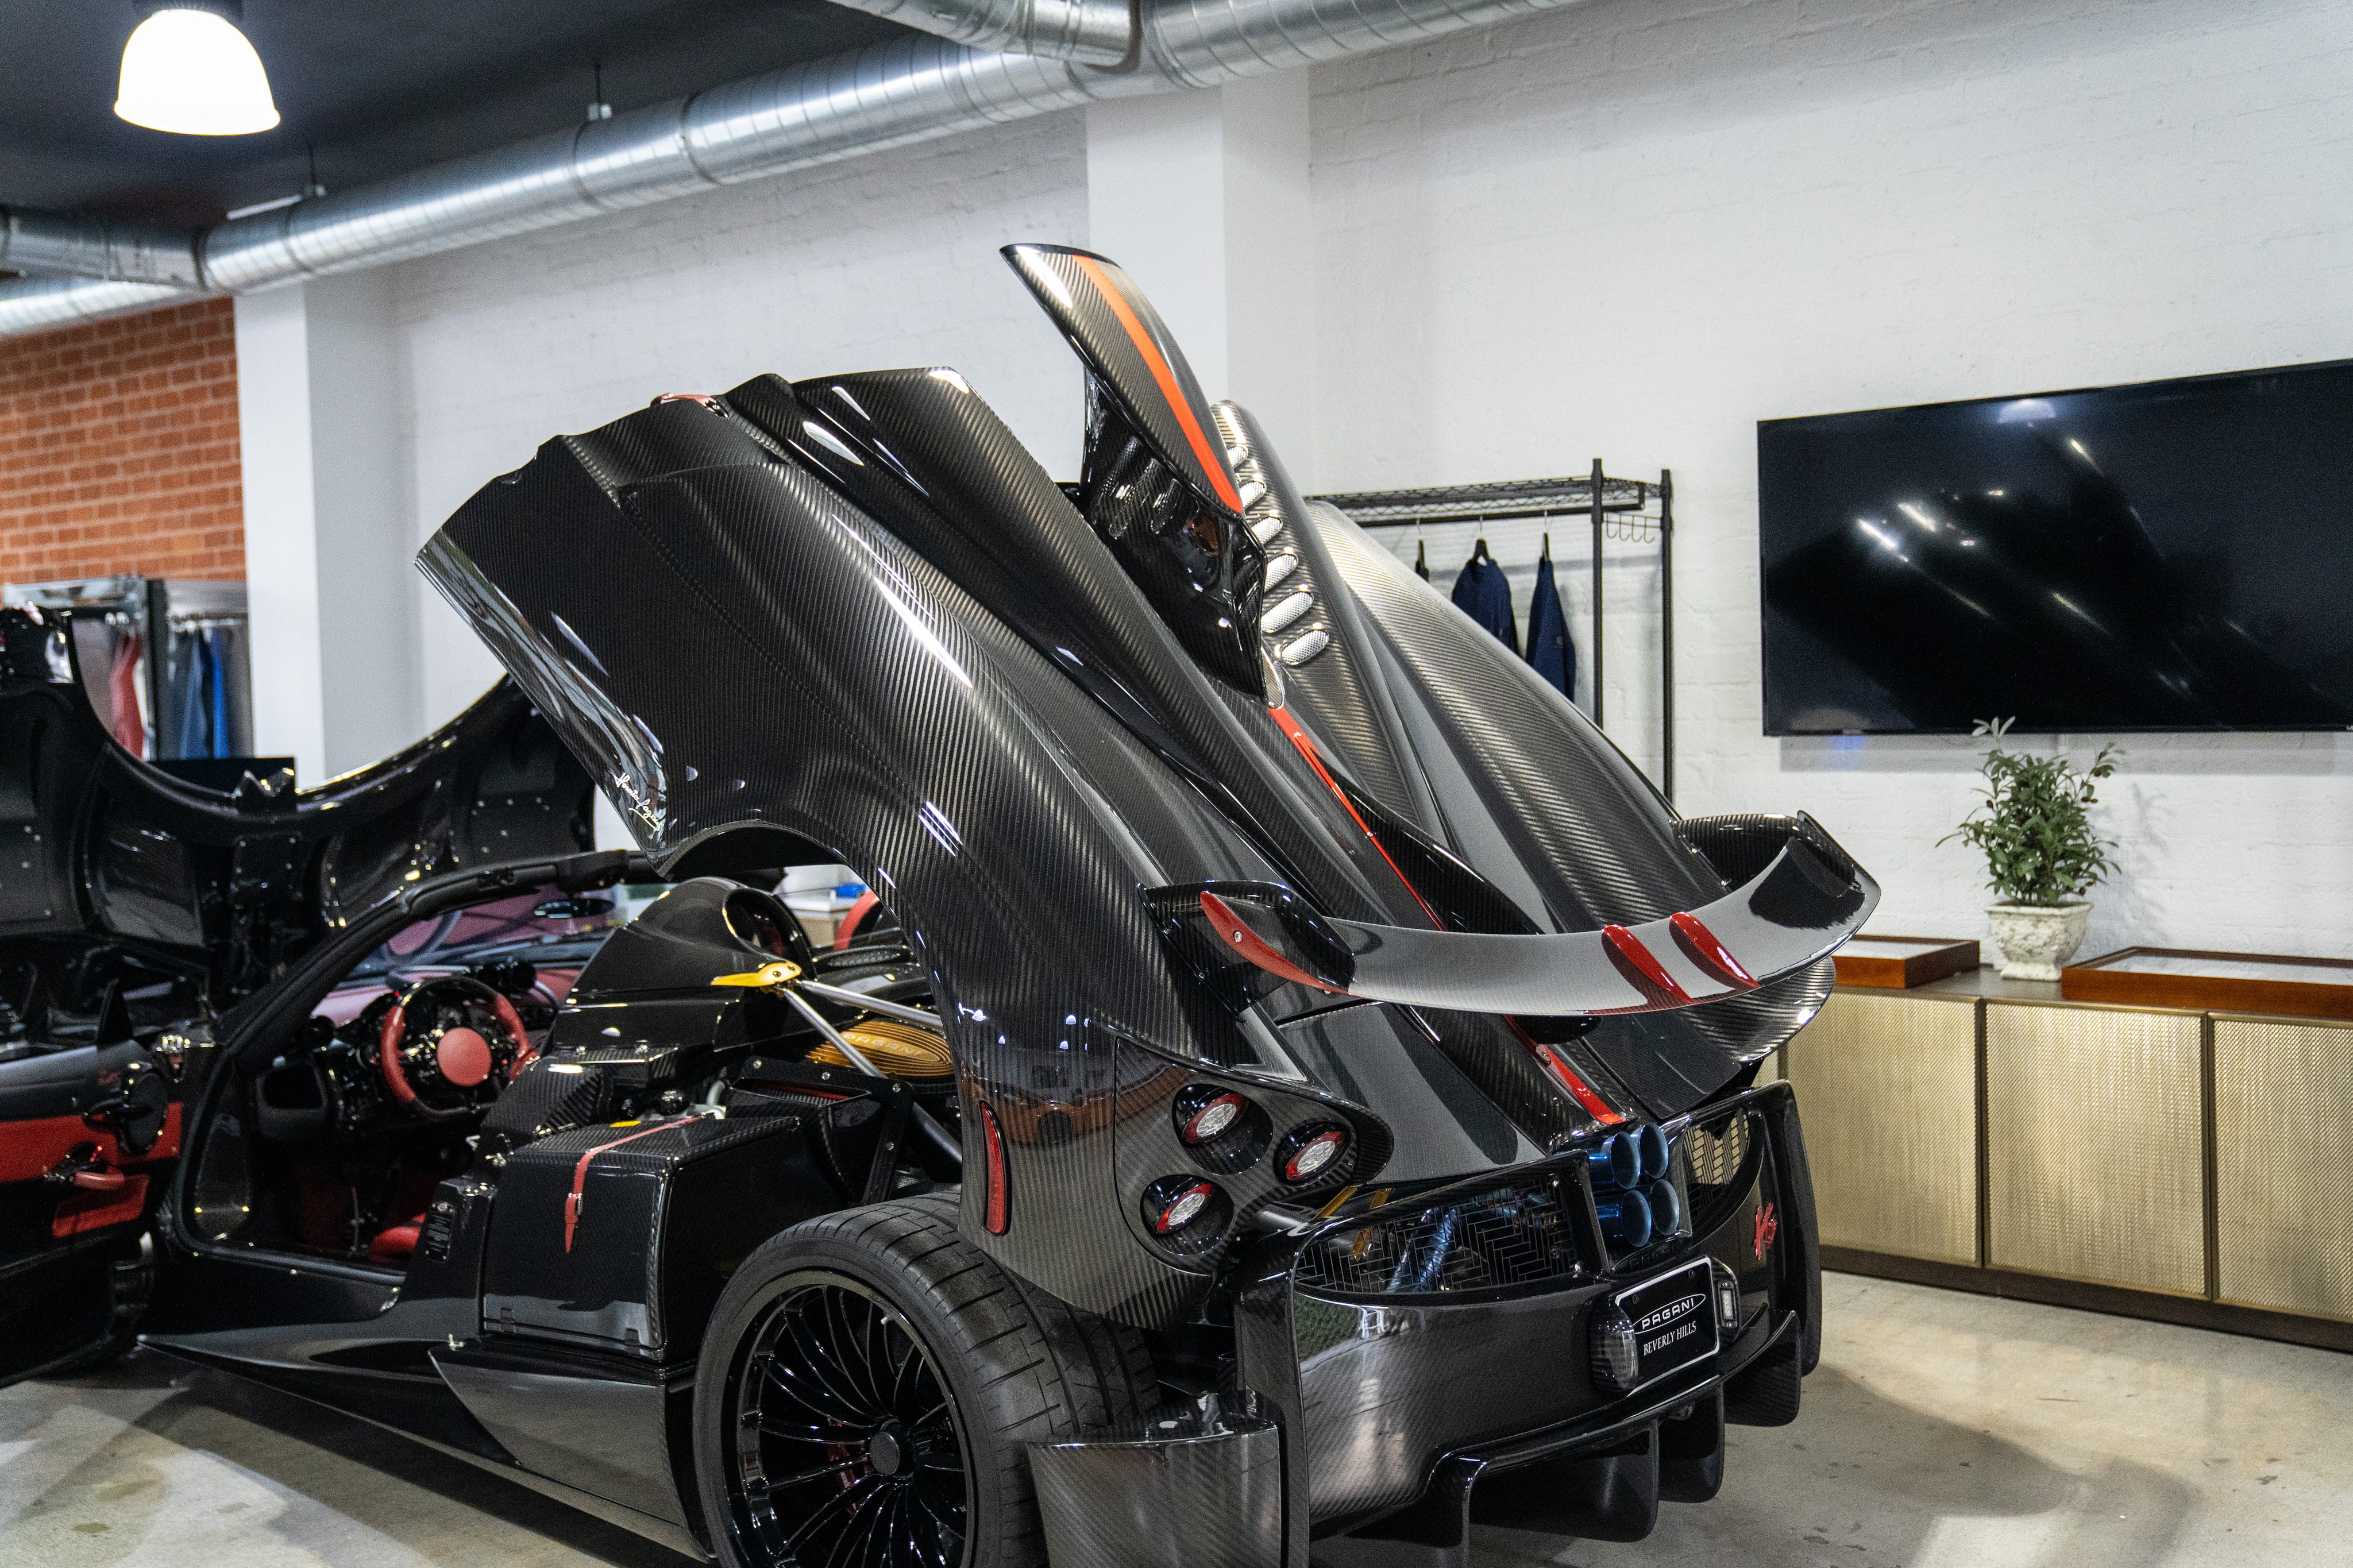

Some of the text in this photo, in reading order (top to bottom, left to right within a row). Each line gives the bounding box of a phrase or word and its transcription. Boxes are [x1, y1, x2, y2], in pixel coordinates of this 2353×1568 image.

[843, 1034, 921, 1056] PAGANI
[1642, 1298, 1694, 1330] PAGANI
[1644, 1320, 1696, 1356] BEVERLY HILLS
